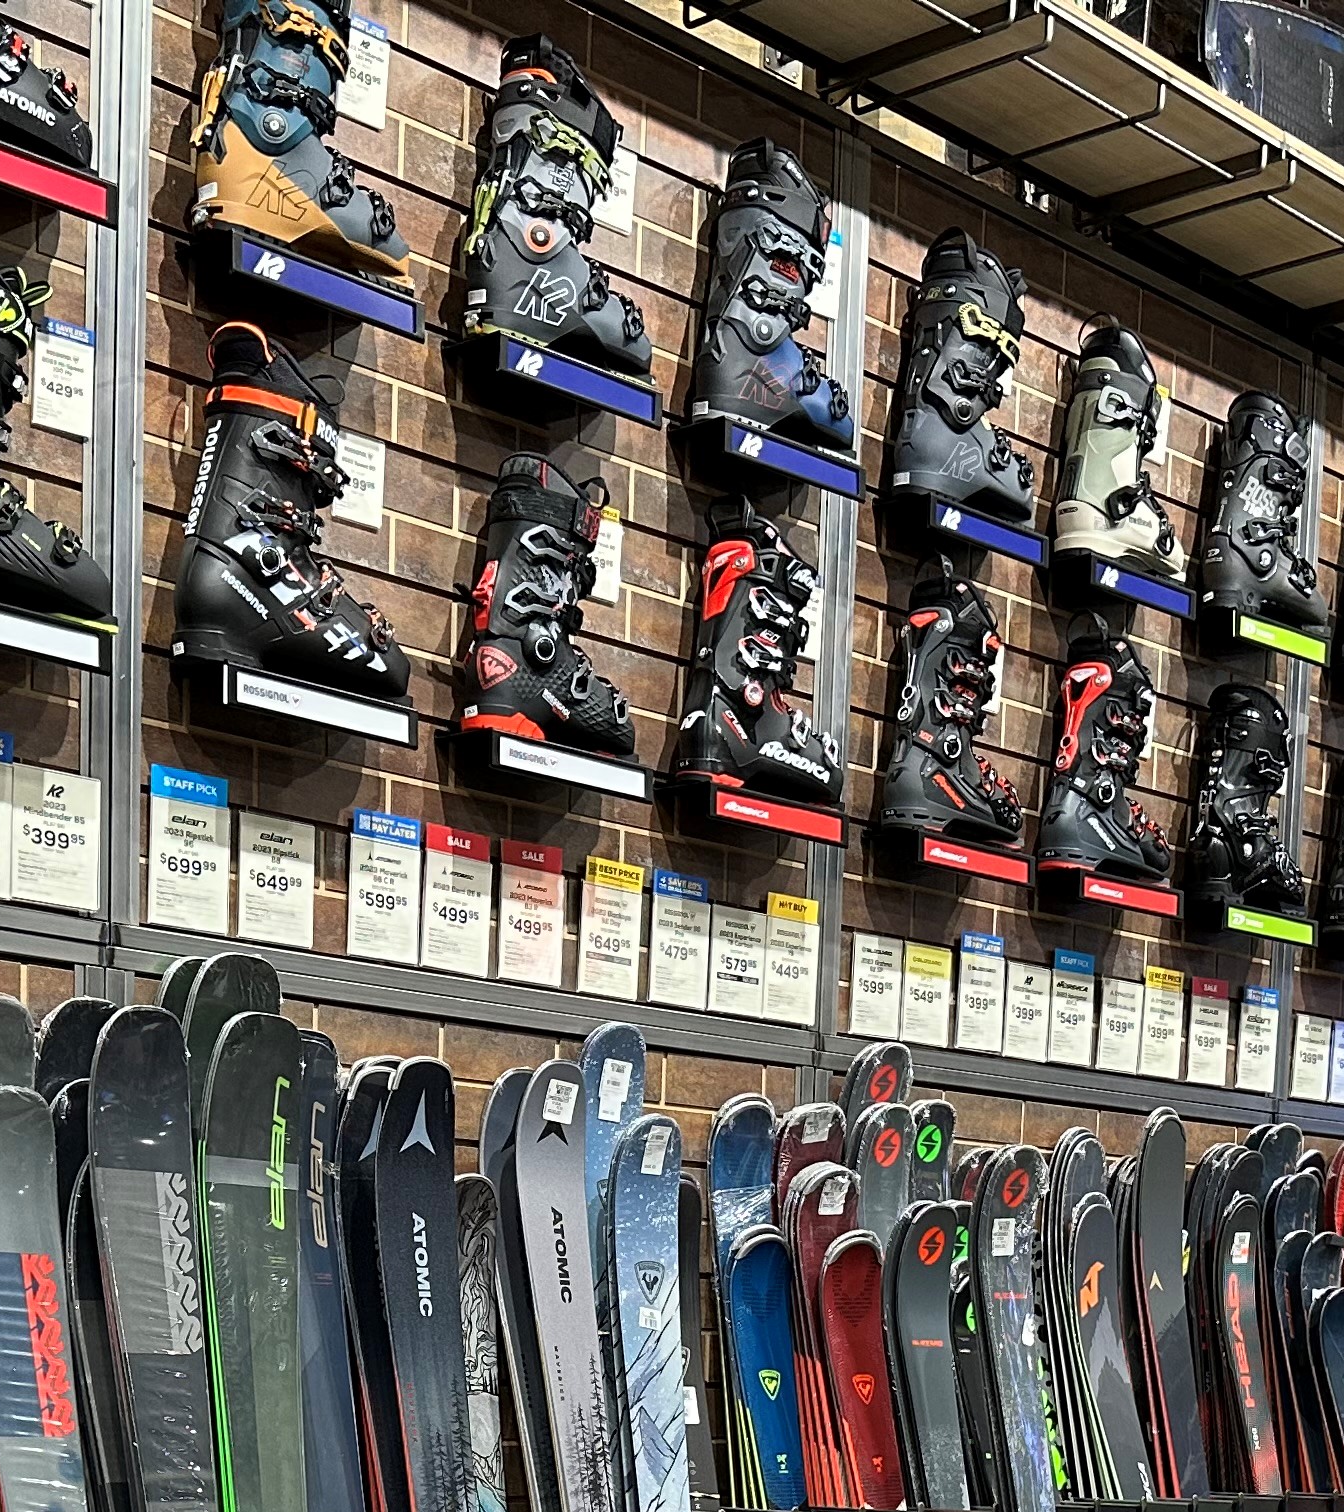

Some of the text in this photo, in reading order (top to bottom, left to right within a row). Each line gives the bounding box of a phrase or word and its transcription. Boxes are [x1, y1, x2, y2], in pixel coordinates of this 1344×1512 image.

[244, 160, 319, 222] K2
[252, 252, 286, 282] K2
[513, 268, 579, 326] K2
[515, 351, 544, 378] K2
[738, 432, 763, 459] K2
[939, 440, 983, 482] K2
[182, 419, 223, 536] ROSSIGNOL
[221, 569, 270, 621] ROSSIGNOL
[243, 683, 291, 704] ROSSIGNOL
[758, 740, 831, 785] NORDICA
[45, 783, 65, 799] K2
[163, 775, 218, 797] STAFF PICK
[23, 805, 72, 823] Mindbender
[171, 814, 207, 829] elan
[724, 801, 769, 820] NORDICA
[259, 831, 294, 846] elan
[446, 835, 471, 850] SALE
[521, 850, 545, 863] SALE
[267, 1076, 292, 1232] elan
[305, 1100, 327, 1250] elan
[411, 1211, 434, 1318] ATOMIC
[550, 1206, 573, 1304] ATOMIC
